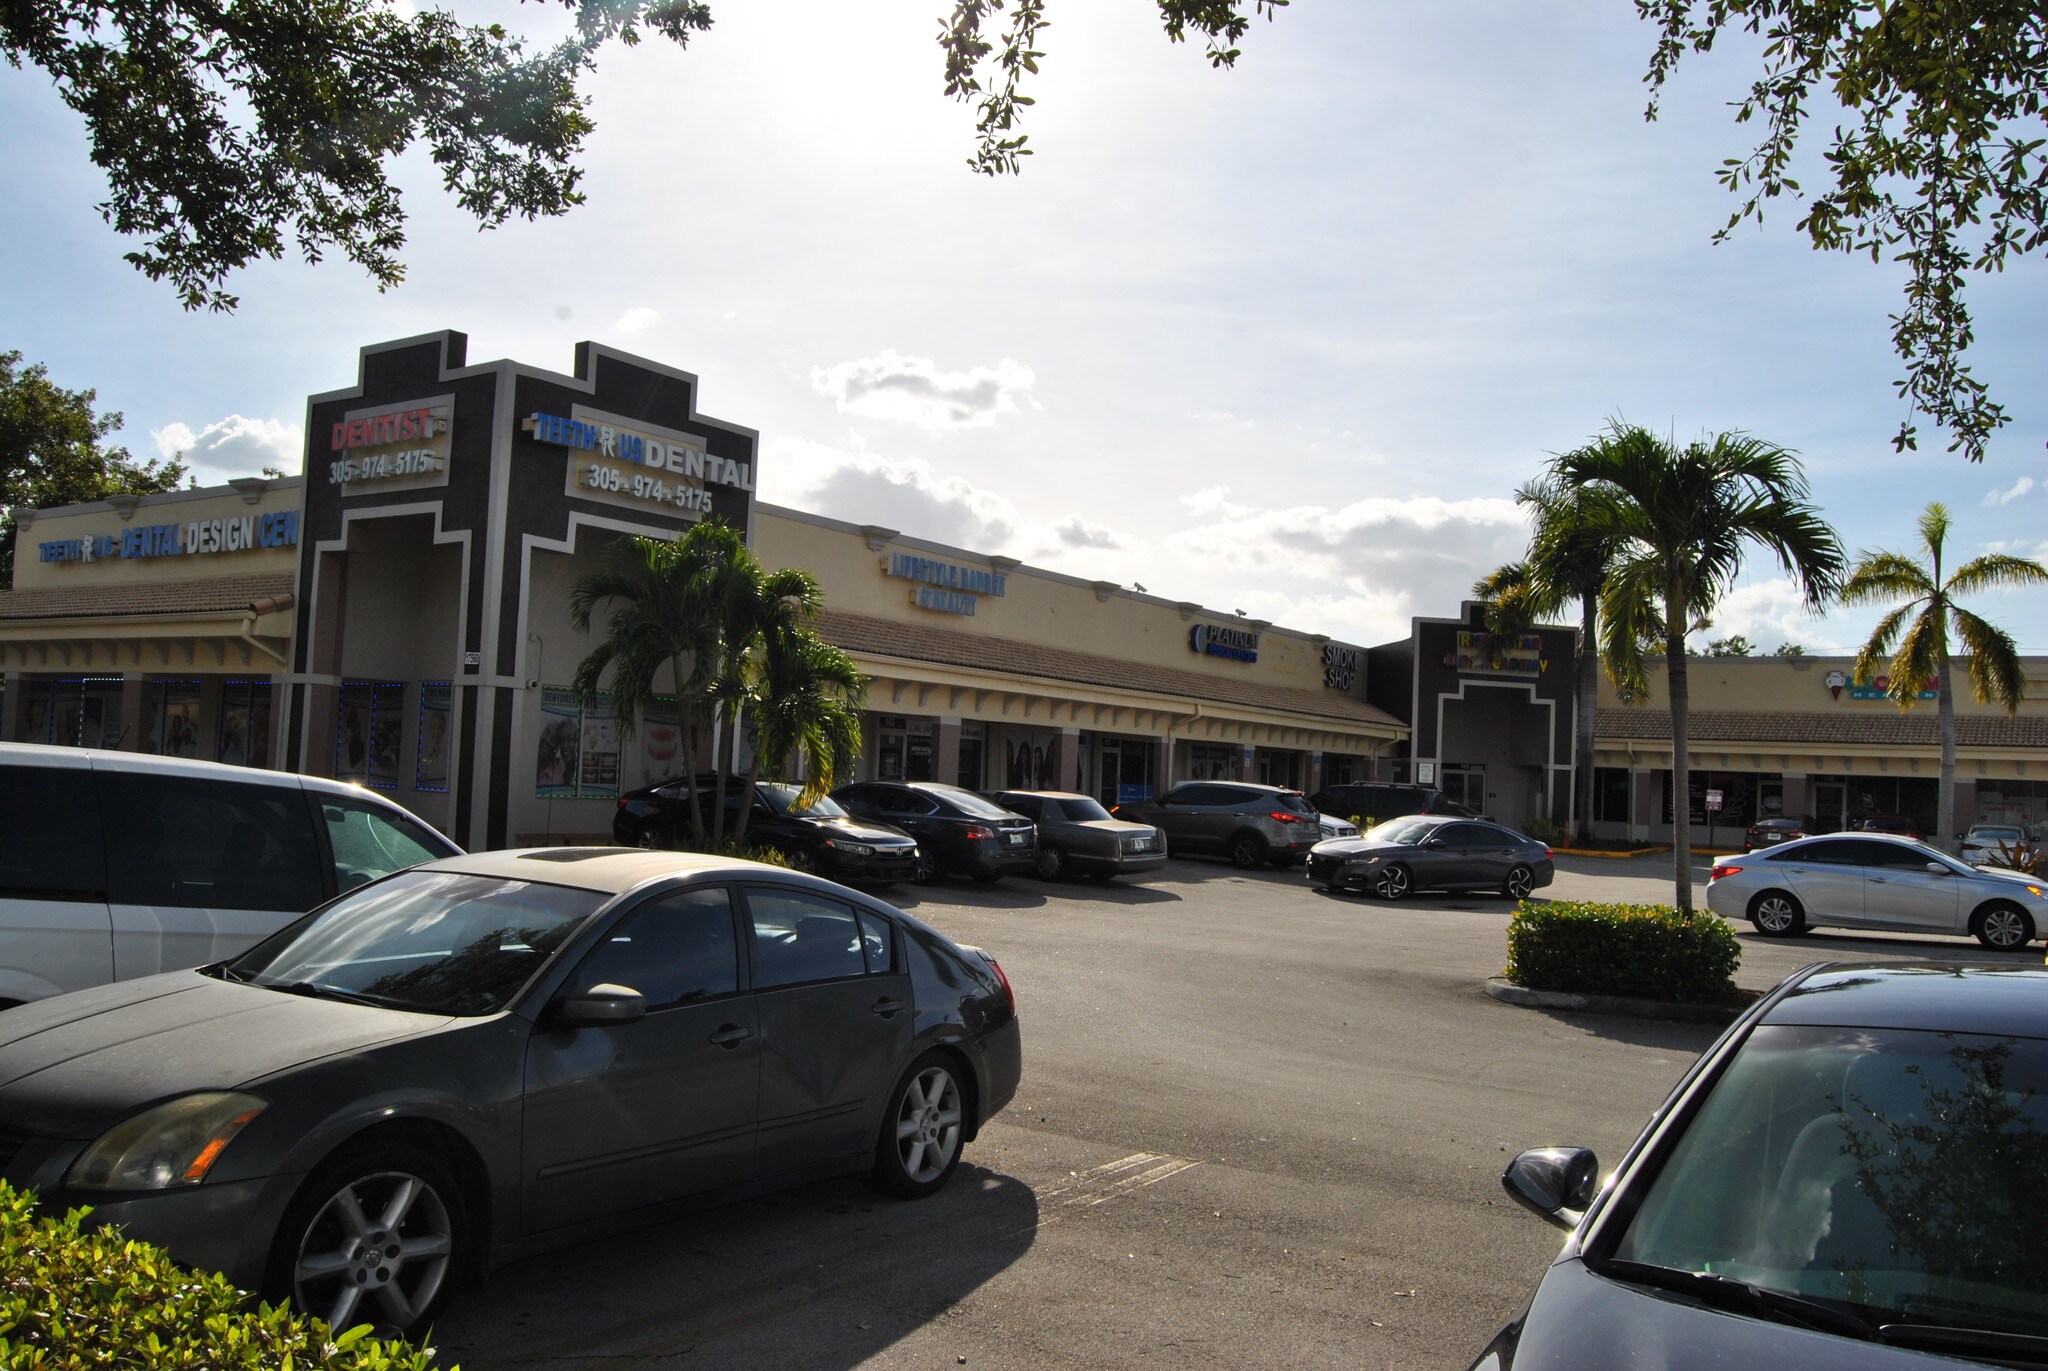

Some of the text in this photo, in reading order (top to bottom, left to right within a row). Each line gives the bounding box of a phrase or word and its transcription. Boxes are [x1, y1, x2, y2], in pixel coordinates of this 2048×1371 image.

[331, 408, 433, 450] DENTIST
[534, 413, 595, 451] TEETH
[620, 432, 643, 463] US
[645, 439, 756, 493] DENTAL
[39, 539, 80, 563] TEETH
[119, 523, 184, 560] DENTAL
[186, 514, 253, 555] DESIGN
[1208, 624, 1259, 650] PLATINUM
[1325, 645, 1360, 670] SMOKE
[1328, 668, 1356, 691] SHOP
[544, 691, 576, 705] DENTURES
